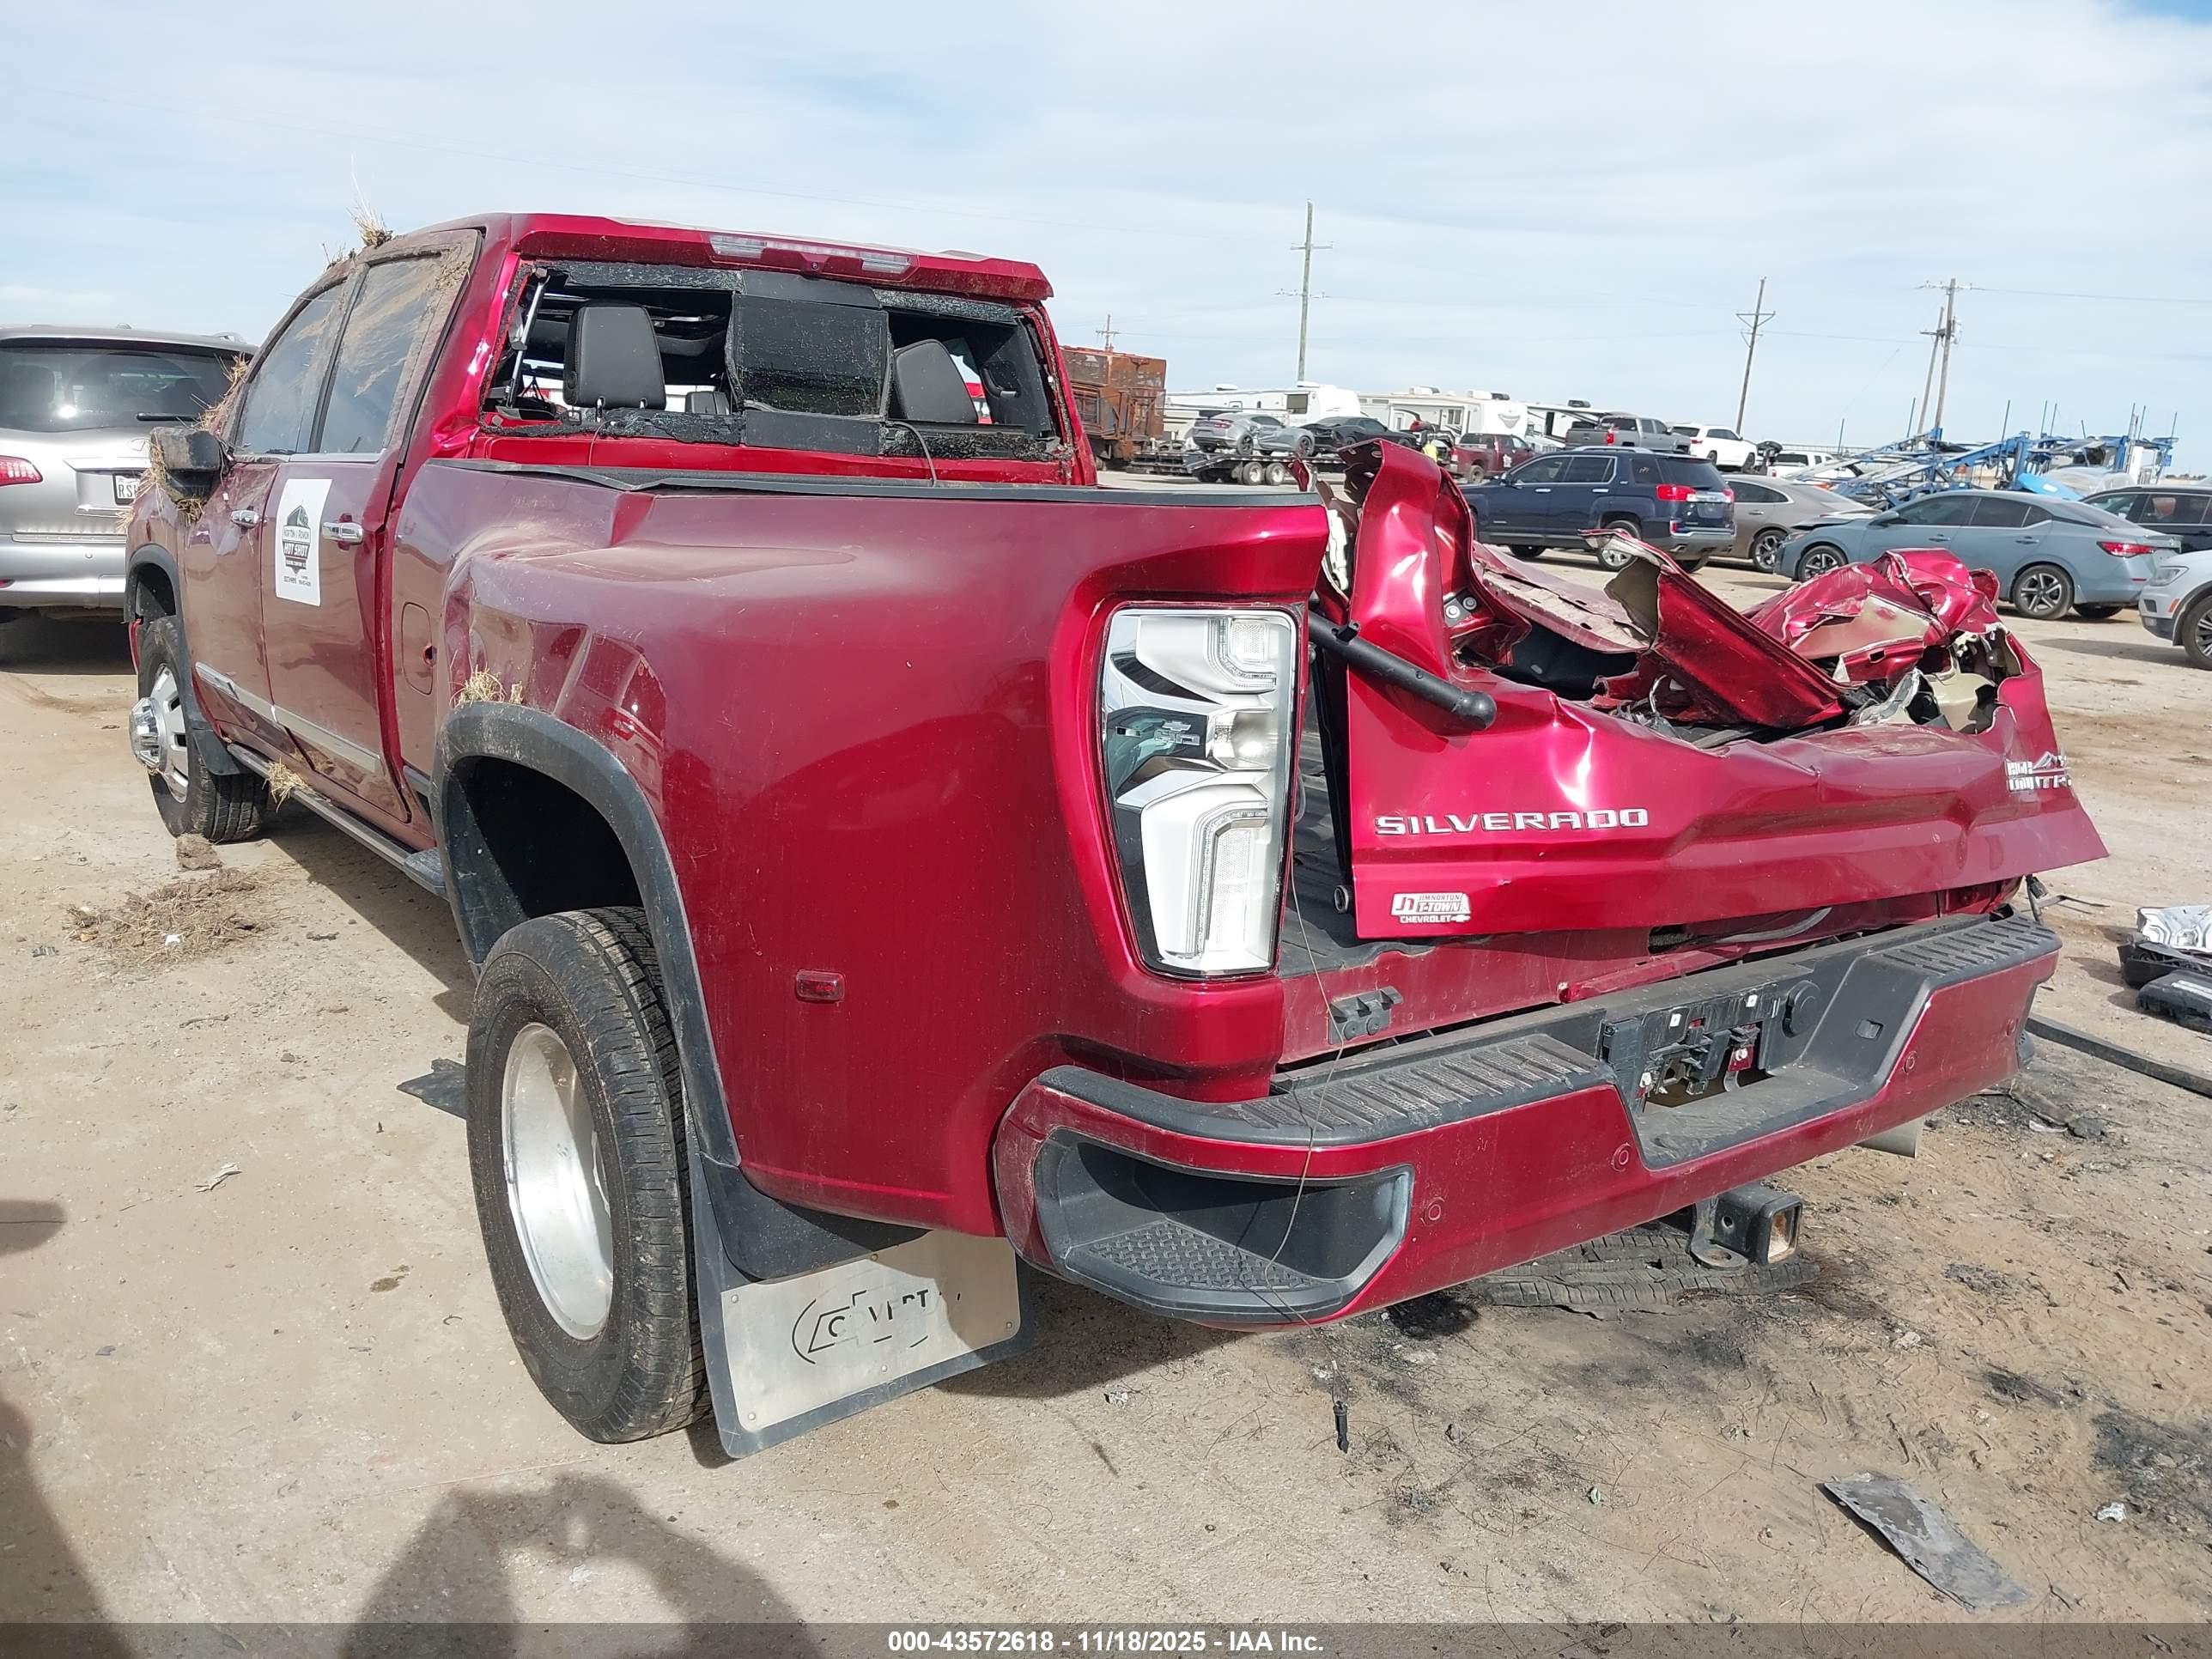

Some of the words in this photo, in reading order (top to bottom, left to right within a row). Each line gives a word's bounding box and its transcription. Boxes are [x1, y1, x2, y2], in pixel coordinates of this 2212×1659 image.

[283, 542, 295, 556] HOT
[295, 544, 308, 557] SHOT
[1375, 808, 1649, 836] SILVERADO
[1416, 901, 1461, 913] T-TOWN
[1399, 915, 1452, 924] CHEVROLET
